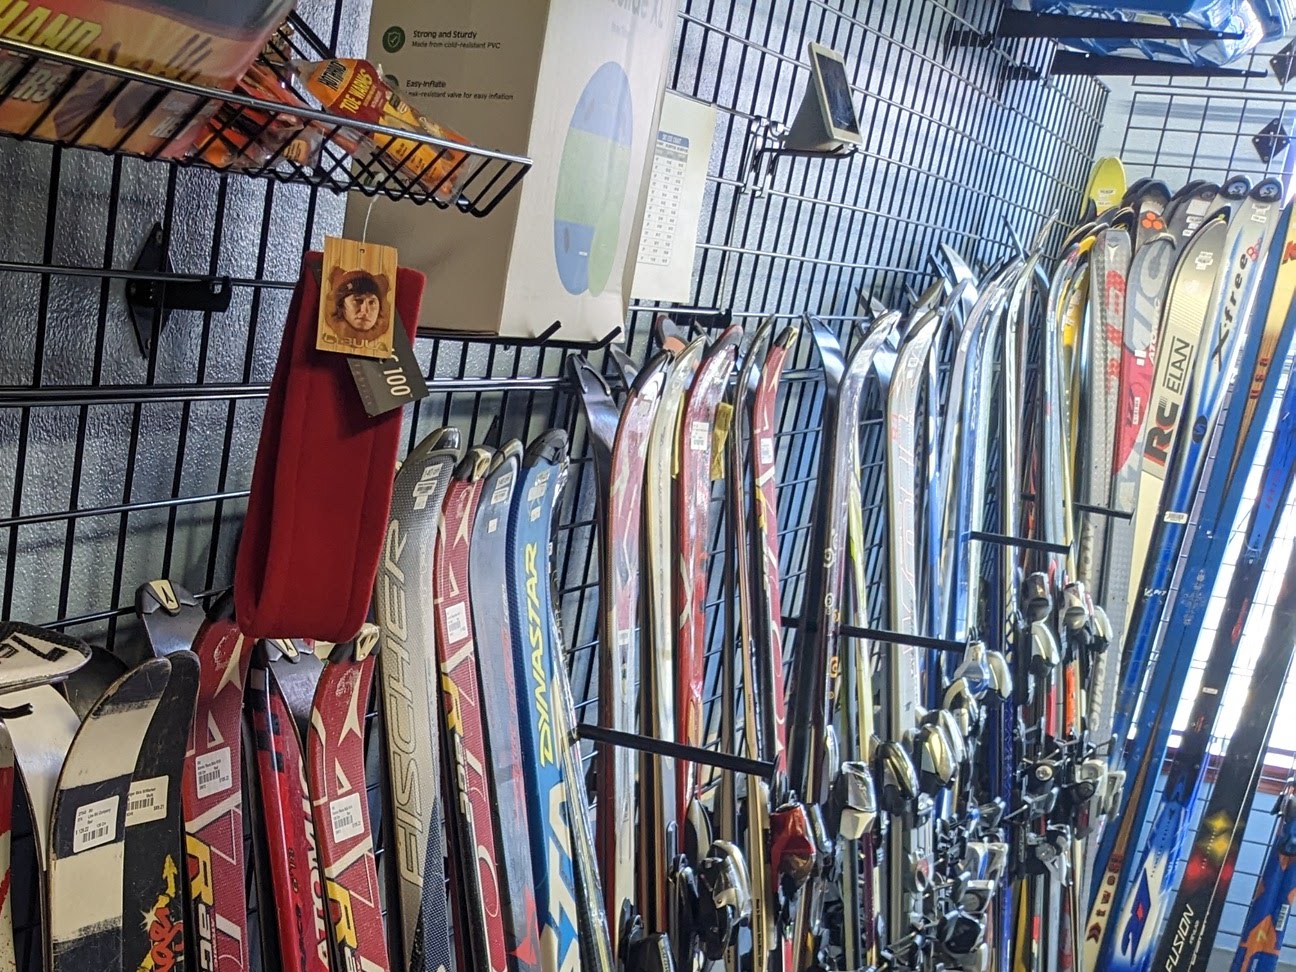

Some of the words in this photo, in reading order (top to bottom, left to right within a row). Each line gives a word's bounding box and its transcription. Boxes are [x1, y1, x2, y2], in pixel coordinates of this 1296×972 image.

[413, 30, 437, 39] Strong
[438, 31, 452, 39] and
[453, 31, 477, 40] Sturdy
[444, 41, 486, 49] cold-resistant
[406, 80, 446, 89] Easy-Inflate
[488, 93, 514, 101] inflation
[1212, 254, 1249, 372] X-free
[383, 366, 413, 397] 100
[1167, 338, 1190, 393] ELAN
[1144, 402, 1180, 467] RC
[524, 541, 554, 768] DYNASTAR
[384, 519, 425, 883] FISCHER
